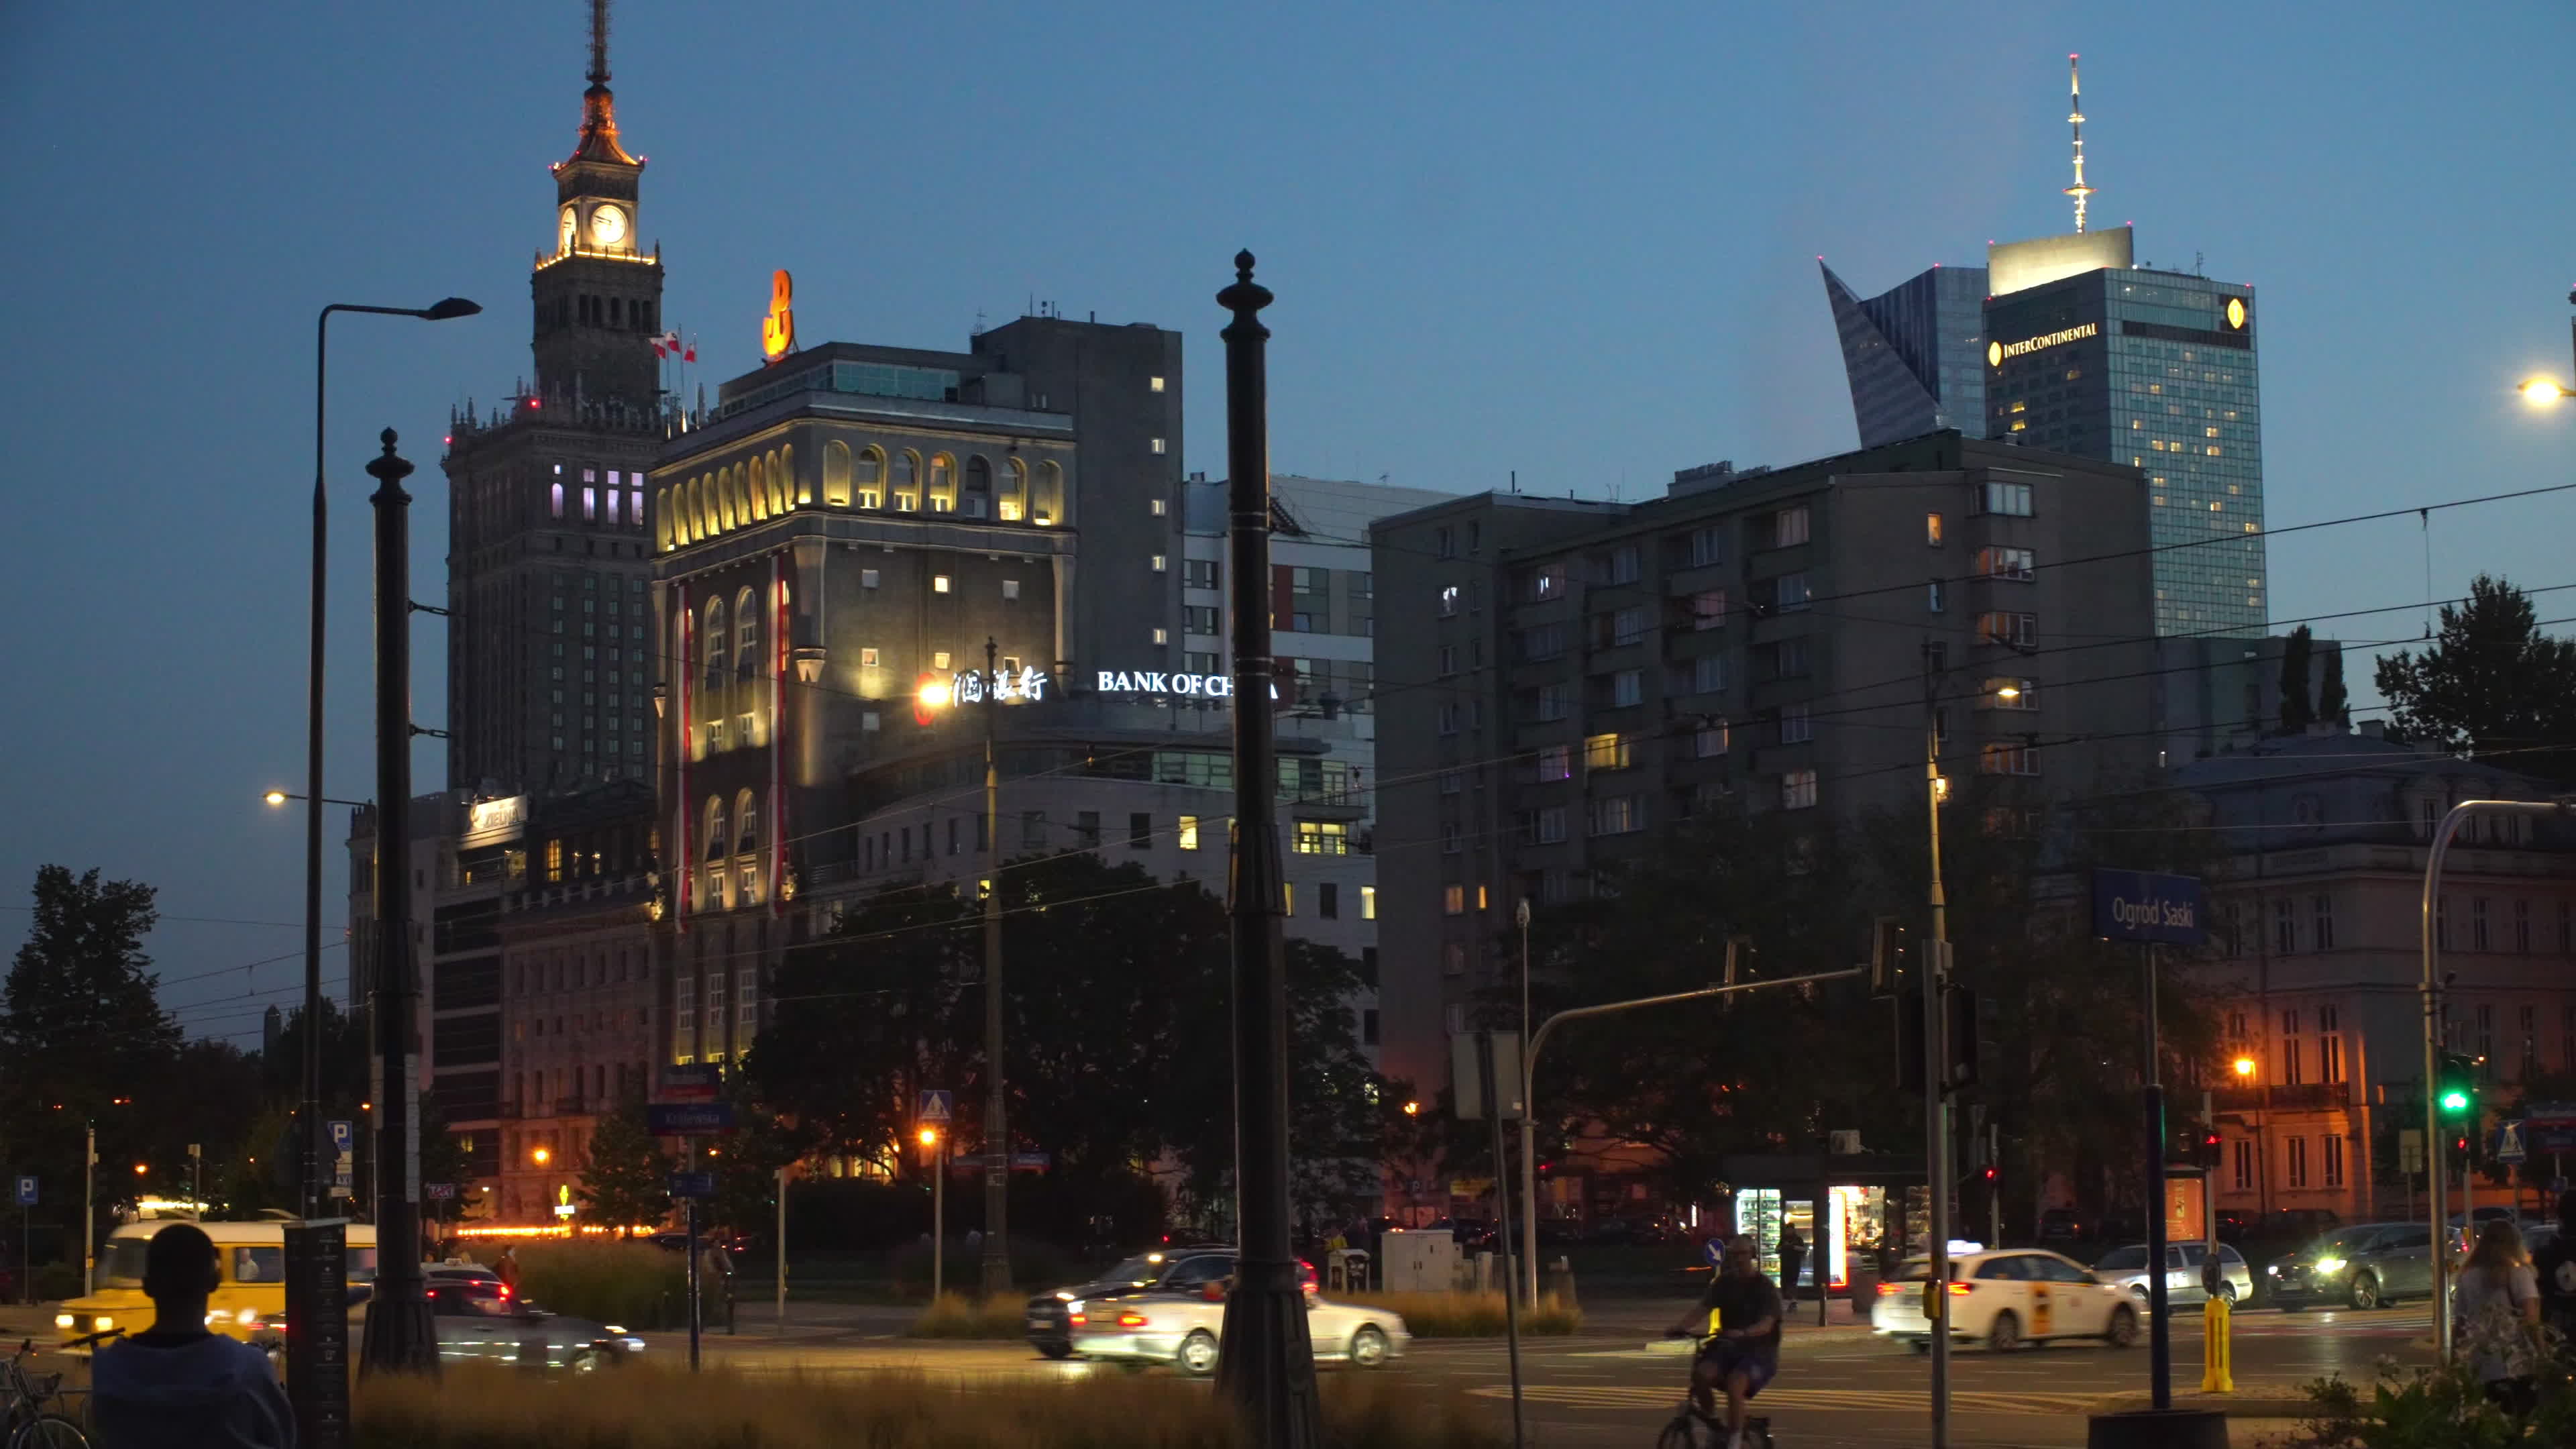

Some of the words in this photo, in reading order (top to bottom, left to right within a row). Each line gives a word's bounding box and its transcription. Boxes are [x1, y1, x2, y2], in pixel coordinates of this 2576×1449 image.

[1097, 671, 1169, 693] BANK
[1172, 674, 1203, 694] OF
[2114, 897, 2159, 930] Ogród
[2163, 900, 2195, 928] Saski
[333, 1124, 347, 1143] P
[21, 1179, 33, 1197] P
